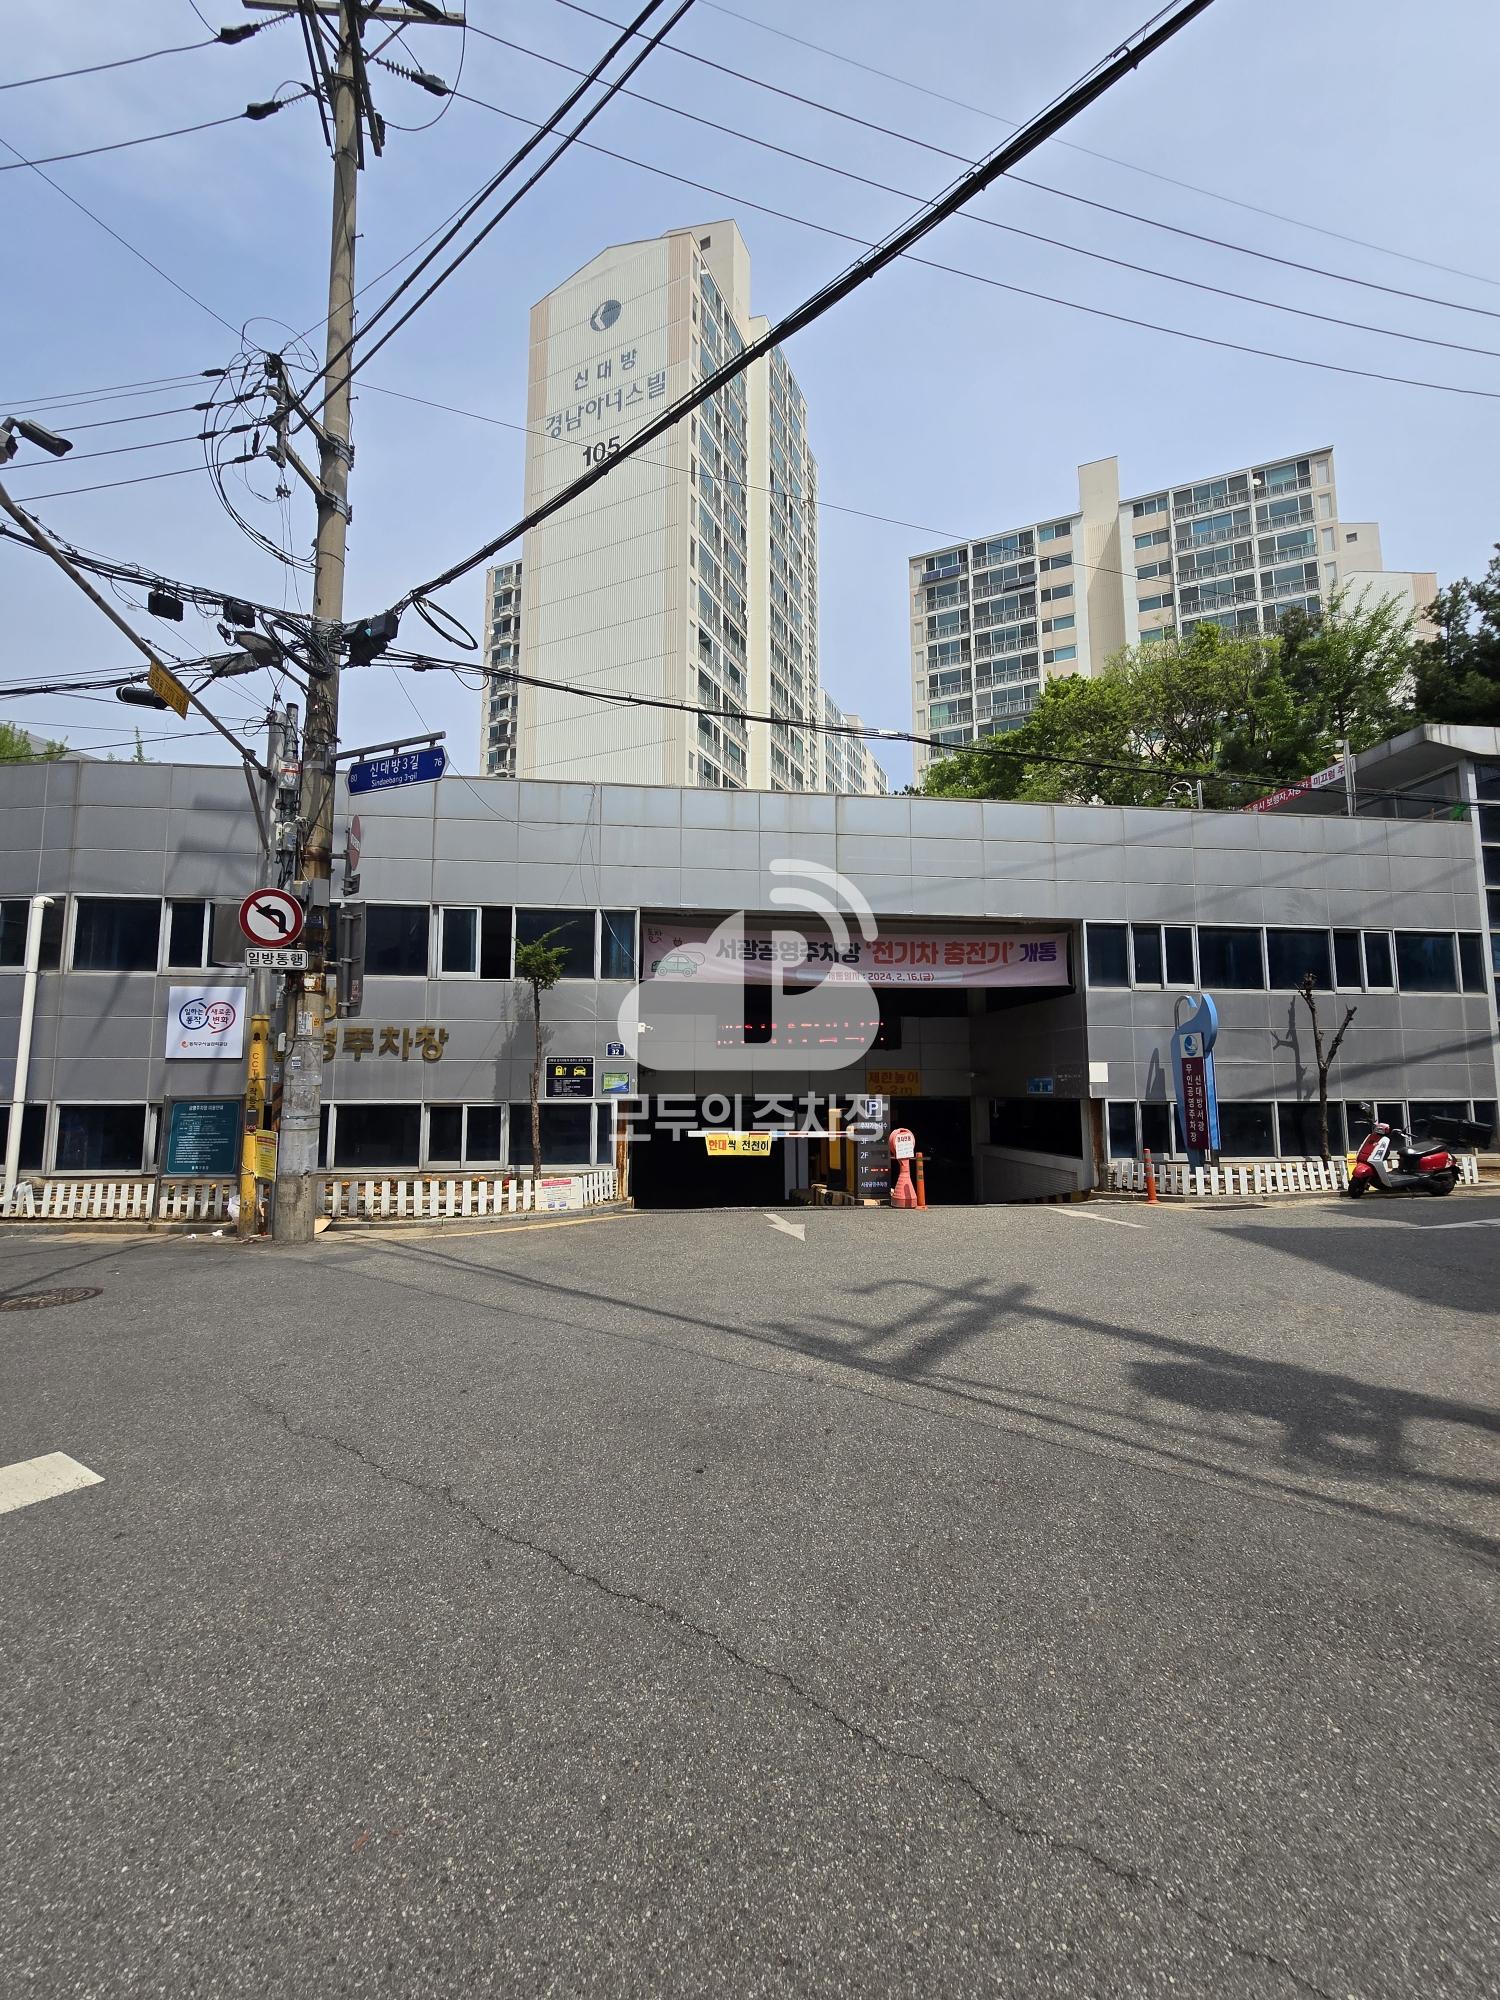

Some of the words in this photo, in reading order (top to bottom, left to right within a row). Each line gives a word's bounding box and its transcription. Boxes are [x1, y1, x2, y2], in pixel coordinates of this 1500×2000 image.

[545, 371, 666, 438] 경남아너스빌
[583, 435, 621, 466] 105
[369, 754, 419, 778] 신대방3길
[434, 757, 443, 767] 76
[371, 776, 403, 788] Sindaebang
[404, 772, 418, 782] 3-gil
[715, 938, 862, 964] 서광공영주차장
[1019, 941, 1057, 963] 개통
[248, 952, 304, 967] 일방통행
[867, 972, 895, 981] 2024.
[184, 1008, 204, 1016] 일하는
[210, 1008, 232, 1016] 새로운
[186, 1016, 202, 1025] 동작
[212, 1016, 229, 1025] 변화
[251, 1052, 259, 1084] CCTV
[868, 1071, 919, 1084] 제한높이
[1185, 1063, 1197, 1142] 무인공영주차장
[1195, 1074, 1204, 1132] 신대방서광
[860, 1137, 869, 1145] 3F
[860, 1152, 869, 1160] 2F
[860, 1166, 869, 1174] 1F
